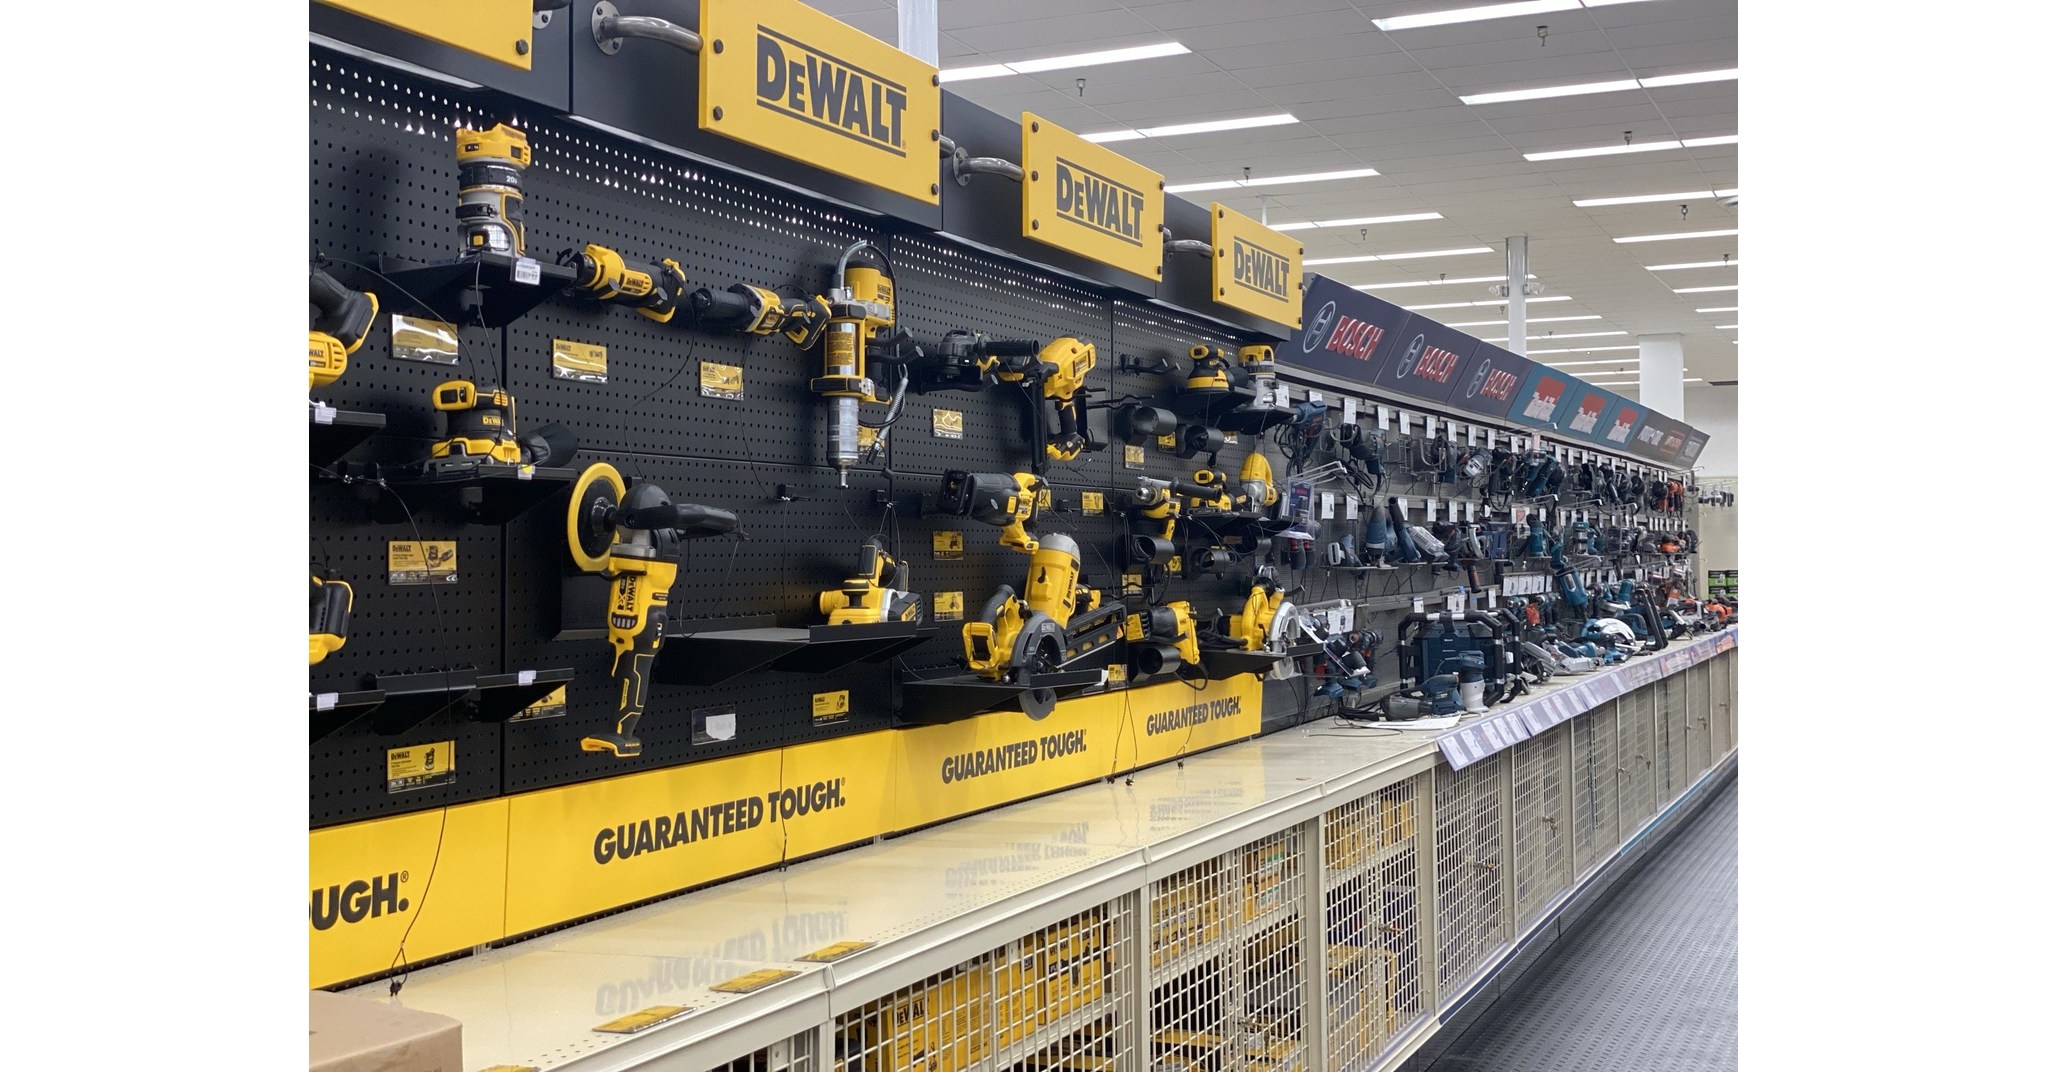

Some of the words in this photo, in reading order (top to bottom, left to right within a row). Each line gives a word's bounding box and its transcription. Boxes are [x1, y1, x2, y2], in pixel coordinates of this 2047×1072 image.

[1325, 314, 1385, 361] BOSCH
[1413, 345, 1459, 383] BOSCH
[1480, 368, 1518, 400] BOSCH
[1146, 703, 1208, 736] GUARANTEED
[942, 739, 1037, 784] GUARANTEED
[594, 796, 764, 865] GUARANTEED
[309, 870, 409, 931] UGH.
